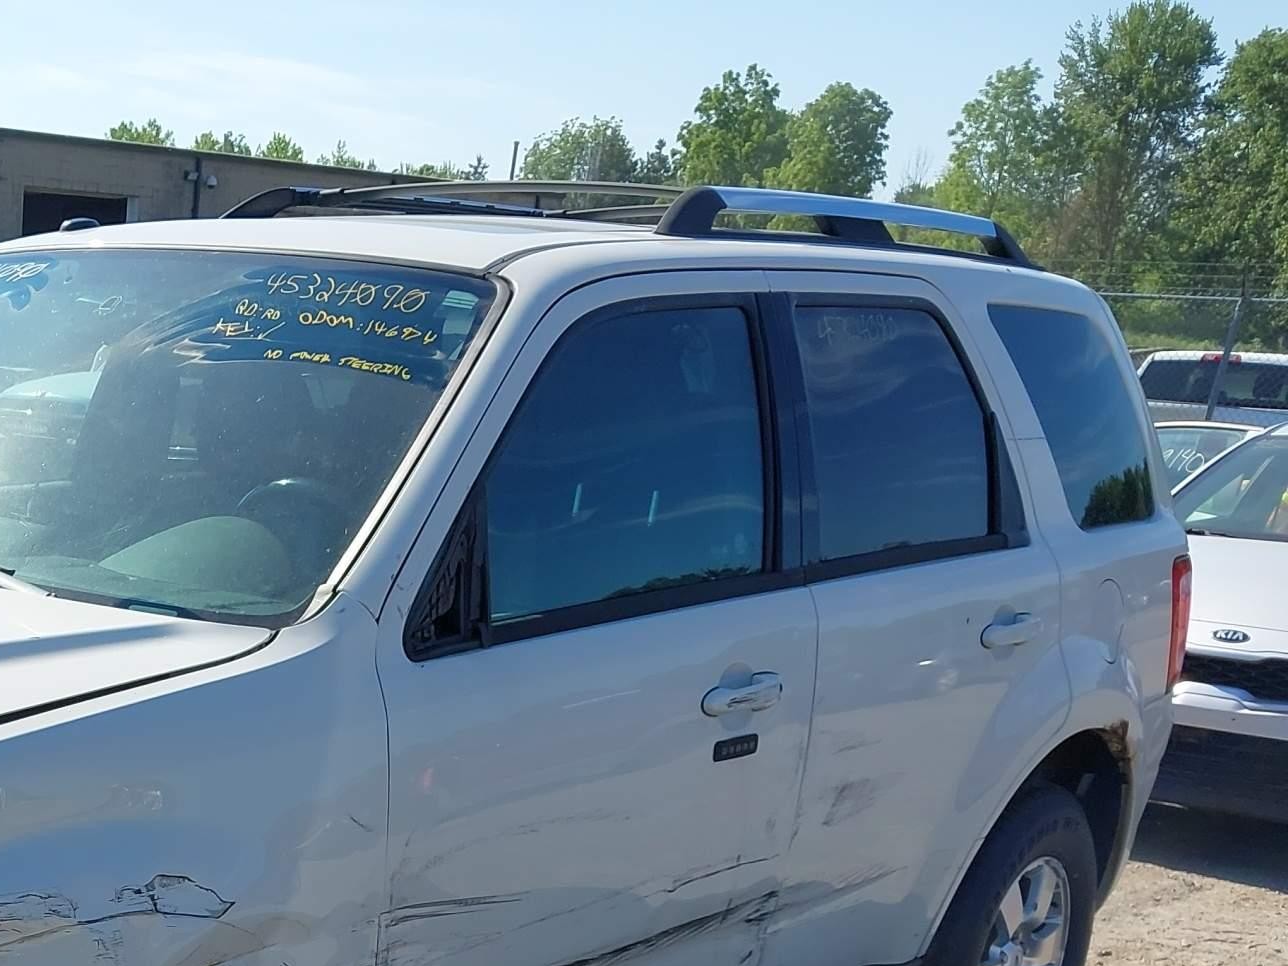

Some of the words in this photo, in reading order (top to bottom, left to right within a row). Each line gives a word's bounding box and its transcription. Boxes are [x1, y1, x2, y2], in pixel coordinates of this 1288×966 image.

[266, 271, 431, 313] 45324090
[263, 349, 283, 360] NO
[338, 356, 411, 380] STEERING
[1214, 630, 1247, 642] KIA
